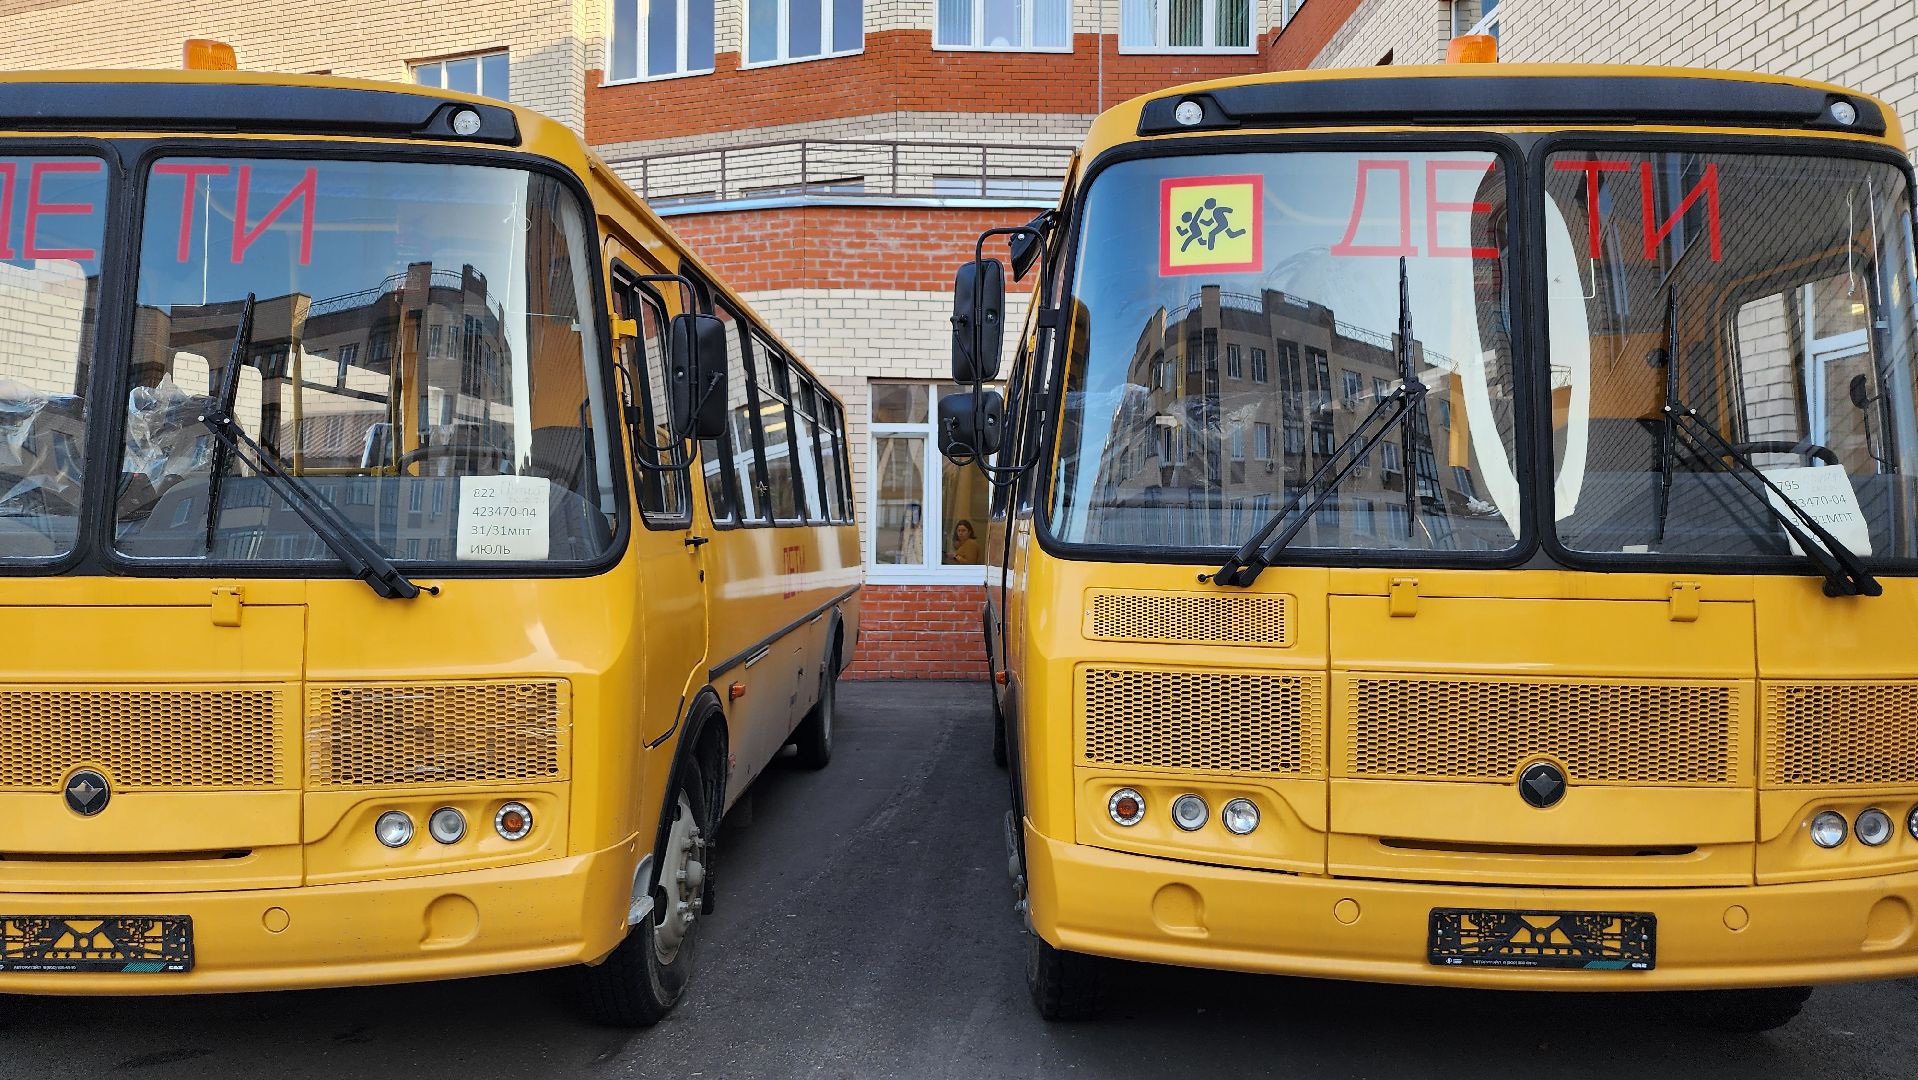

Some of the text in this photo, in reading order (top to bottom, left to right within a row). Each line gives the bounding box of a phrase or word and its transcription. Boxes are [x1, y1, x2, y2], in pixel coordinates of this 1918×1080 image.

[1330, 159, 1722, 263] ДЕТИ
[473, 488, 495, 498] 822
[472, 506, 537, 518] 423470-04
[470, 544, 511, 555] ИЮЛЬ
